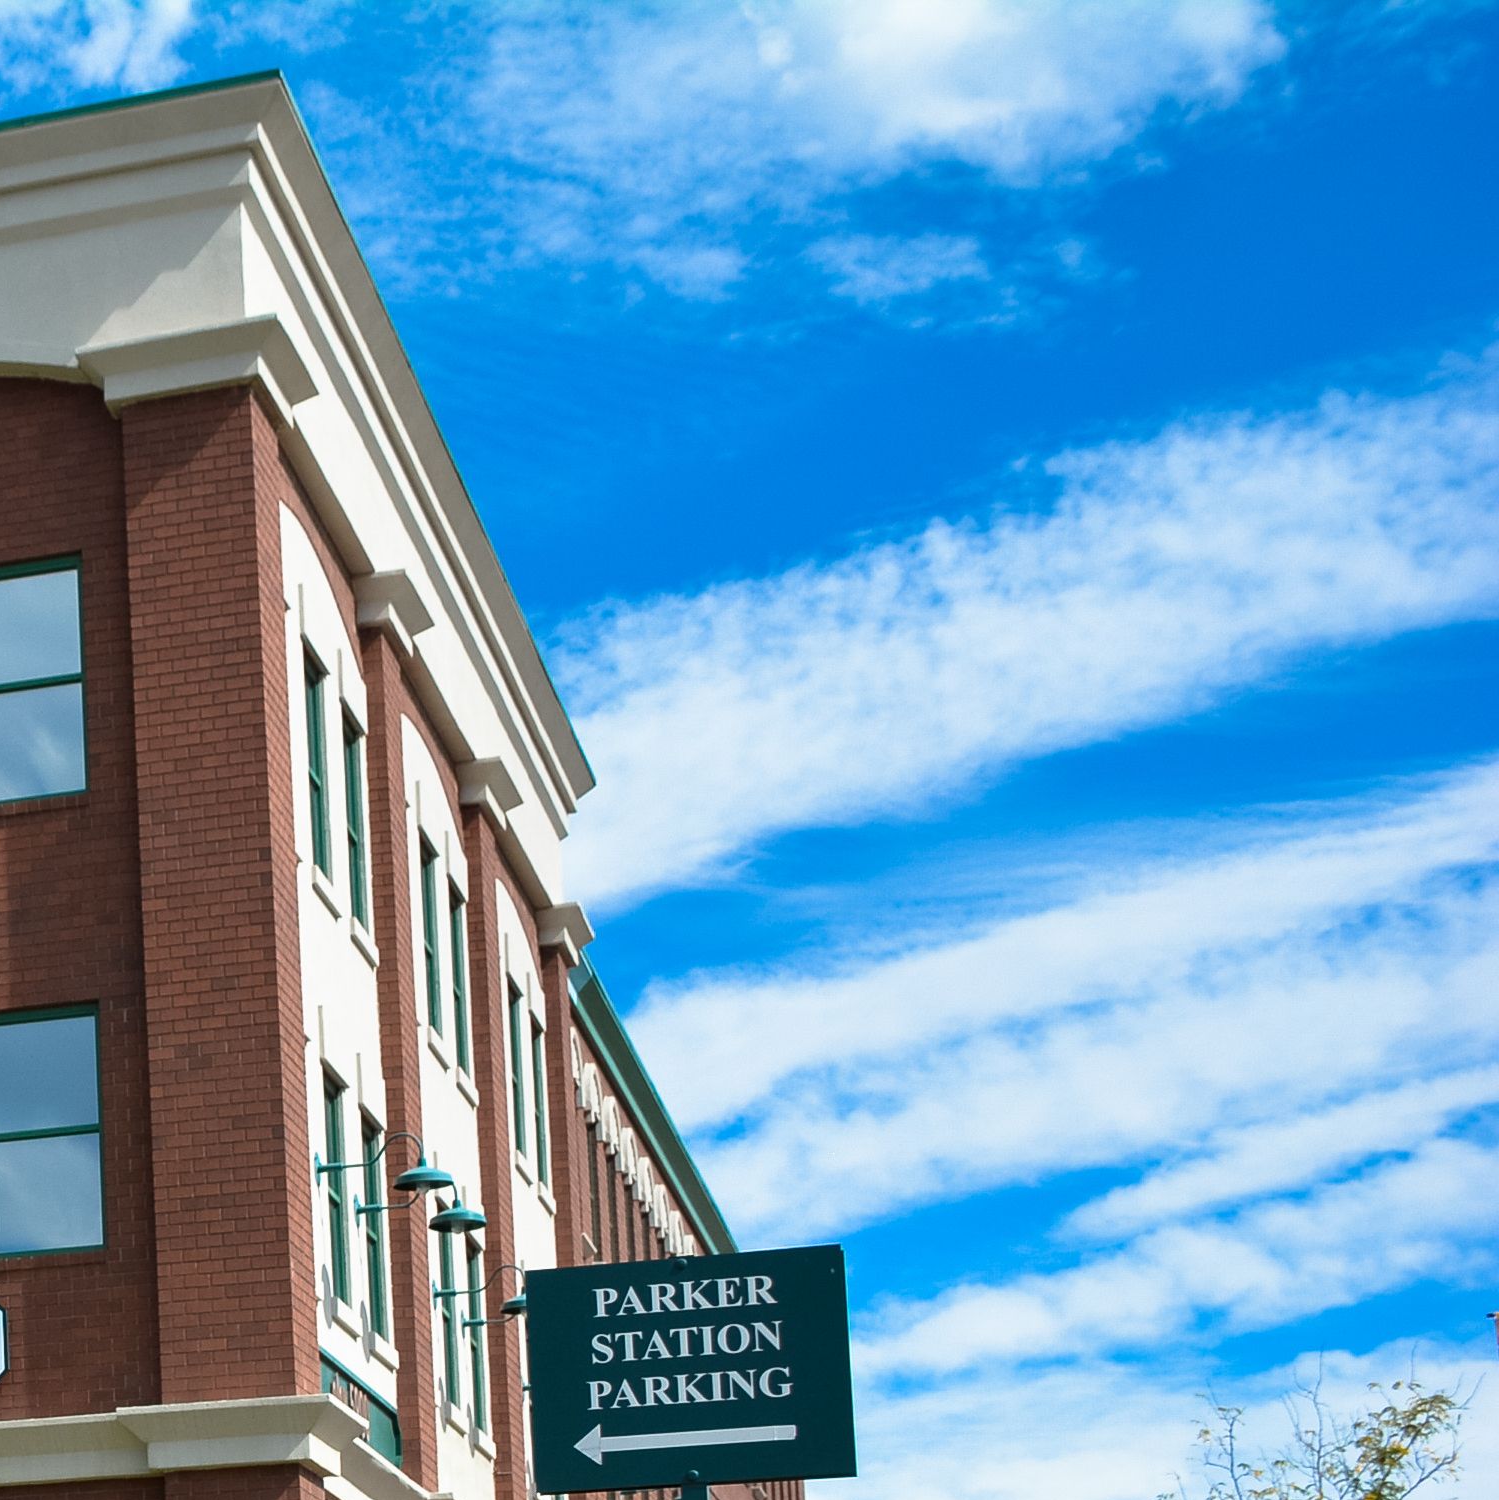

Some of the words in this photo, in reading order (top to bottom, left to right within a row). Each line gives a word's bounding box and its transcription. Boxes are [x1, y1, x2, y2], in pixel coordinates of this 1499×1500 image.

[592, 1275, 779, 1319] PARKER
[591, 1320, 783, 1365] STATION
[586, 1367, 795, 1411] PARKING
